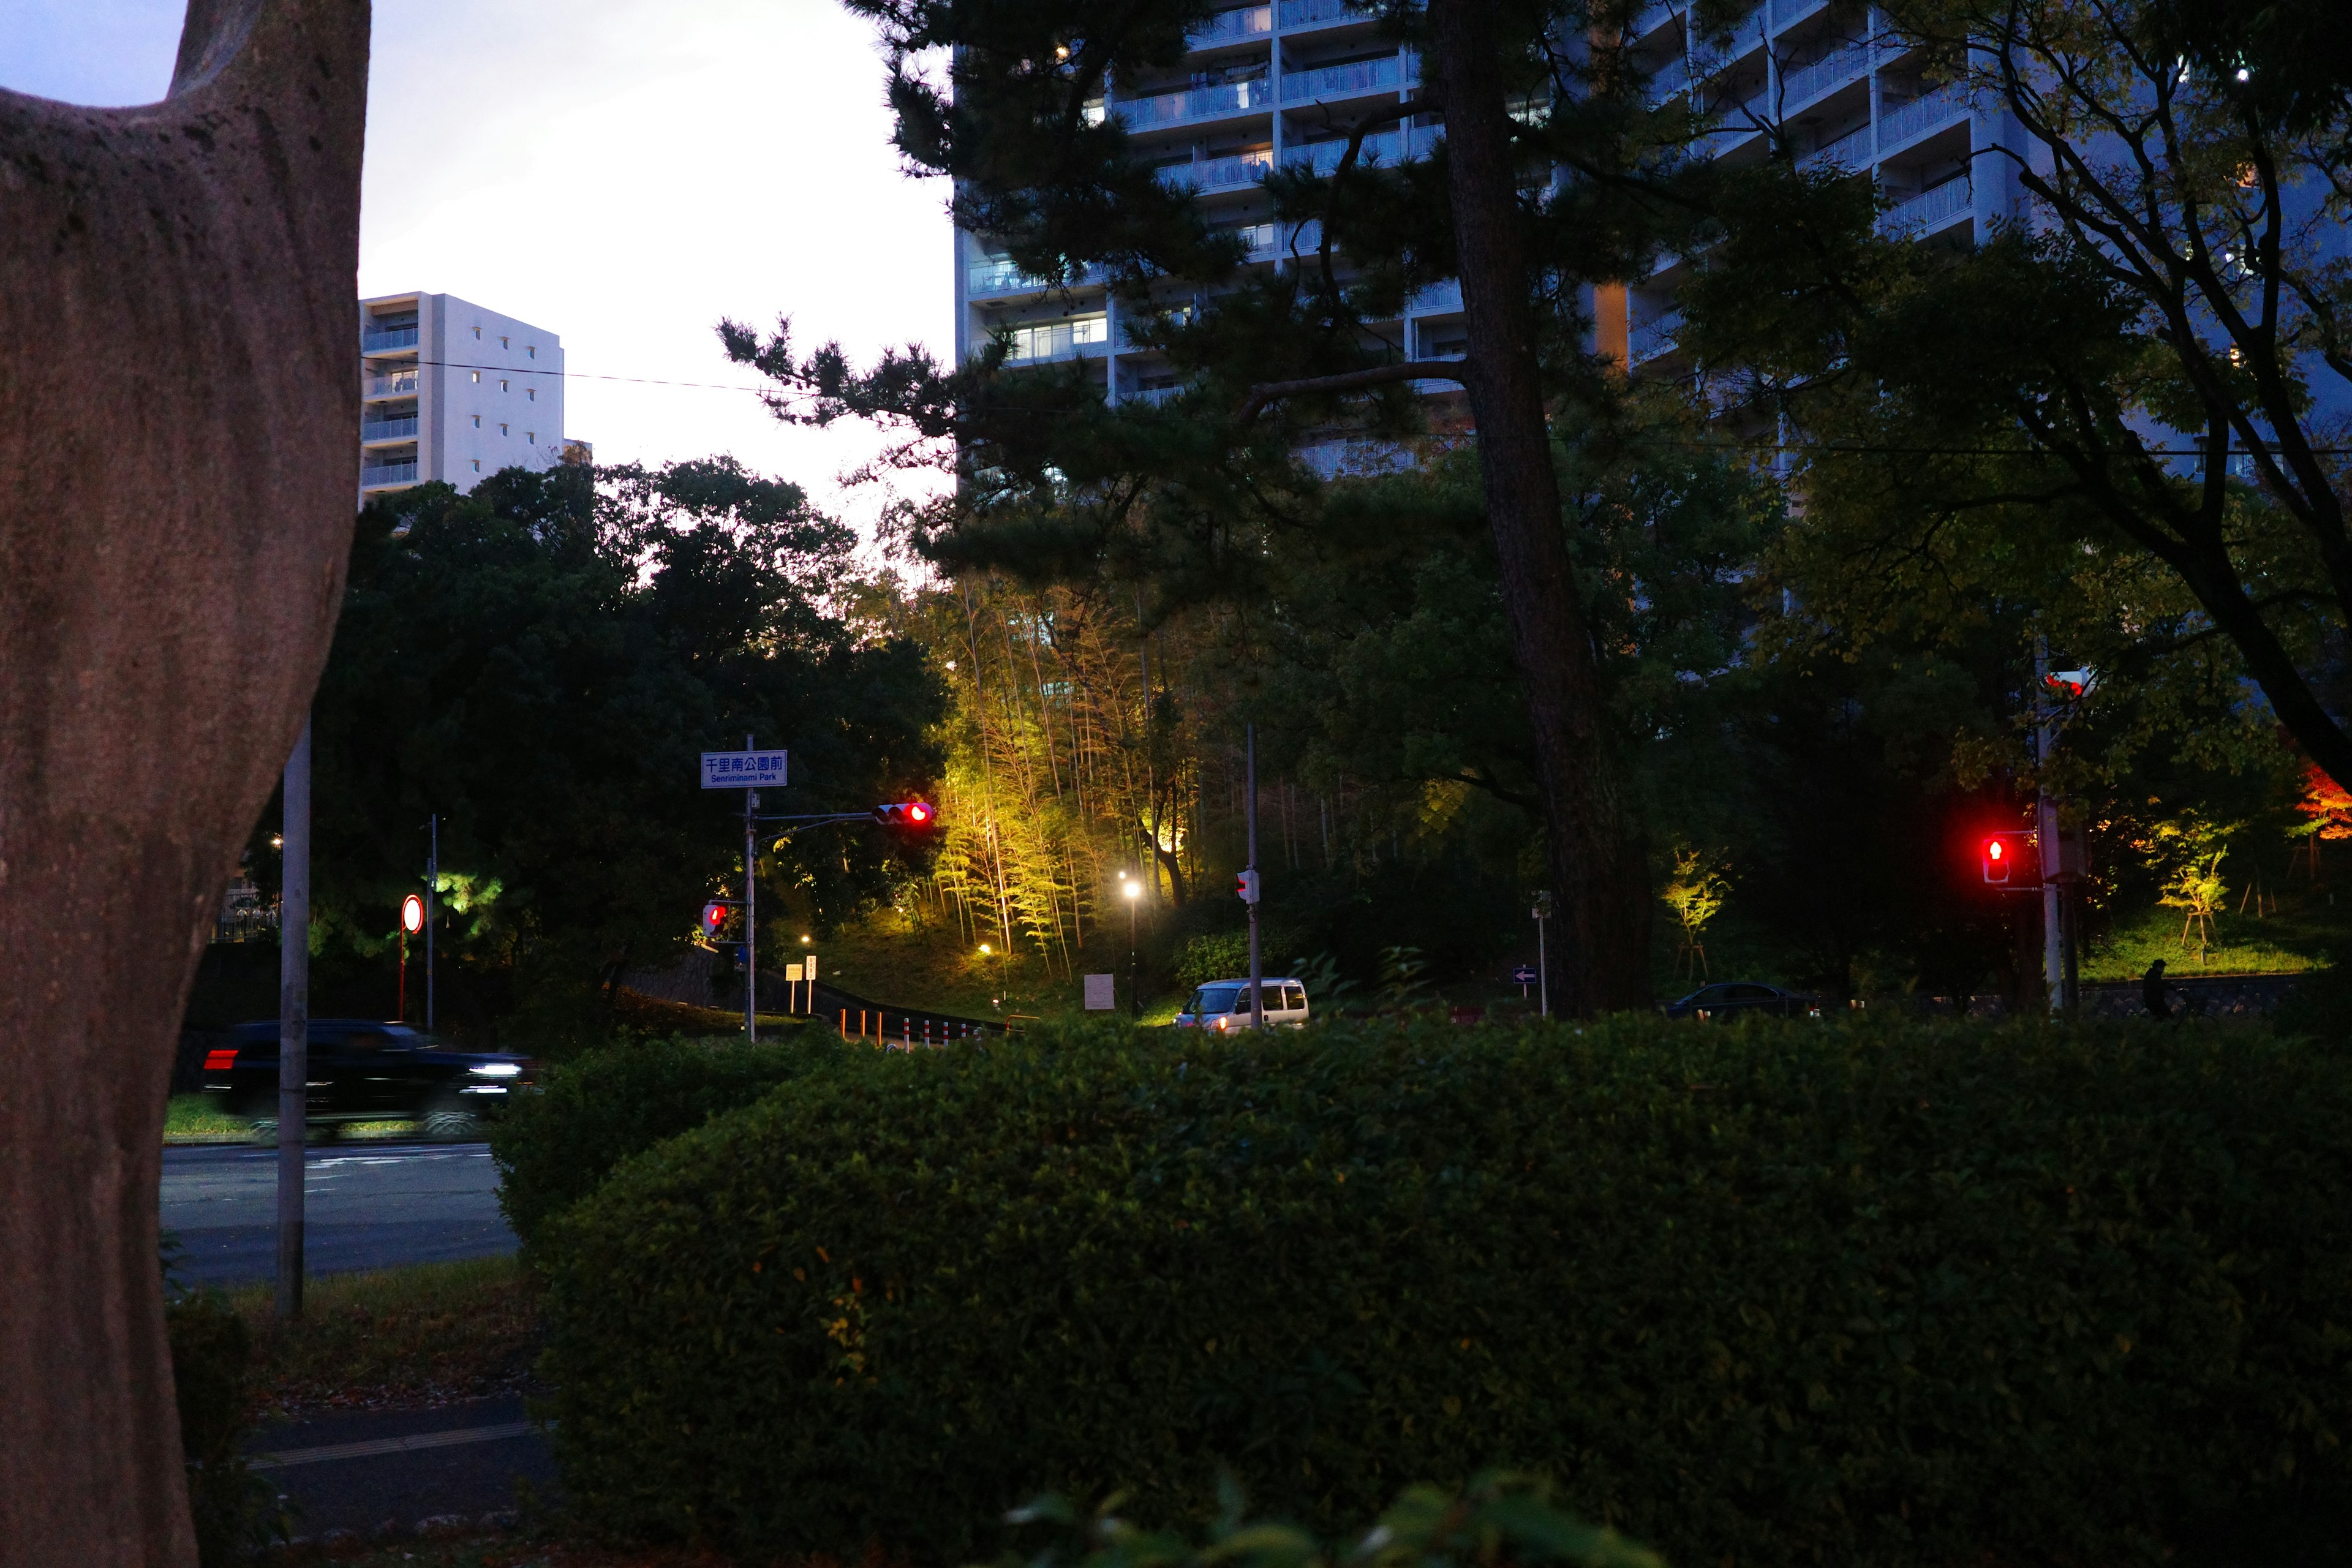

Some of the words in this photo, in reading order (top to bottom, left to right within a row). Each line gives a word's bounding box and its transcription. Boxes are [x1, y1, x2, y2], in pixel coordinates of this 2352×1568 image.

[706, 756, 783, 772] 千里南公園前
[711, 773, 757, 783] Senriminami
